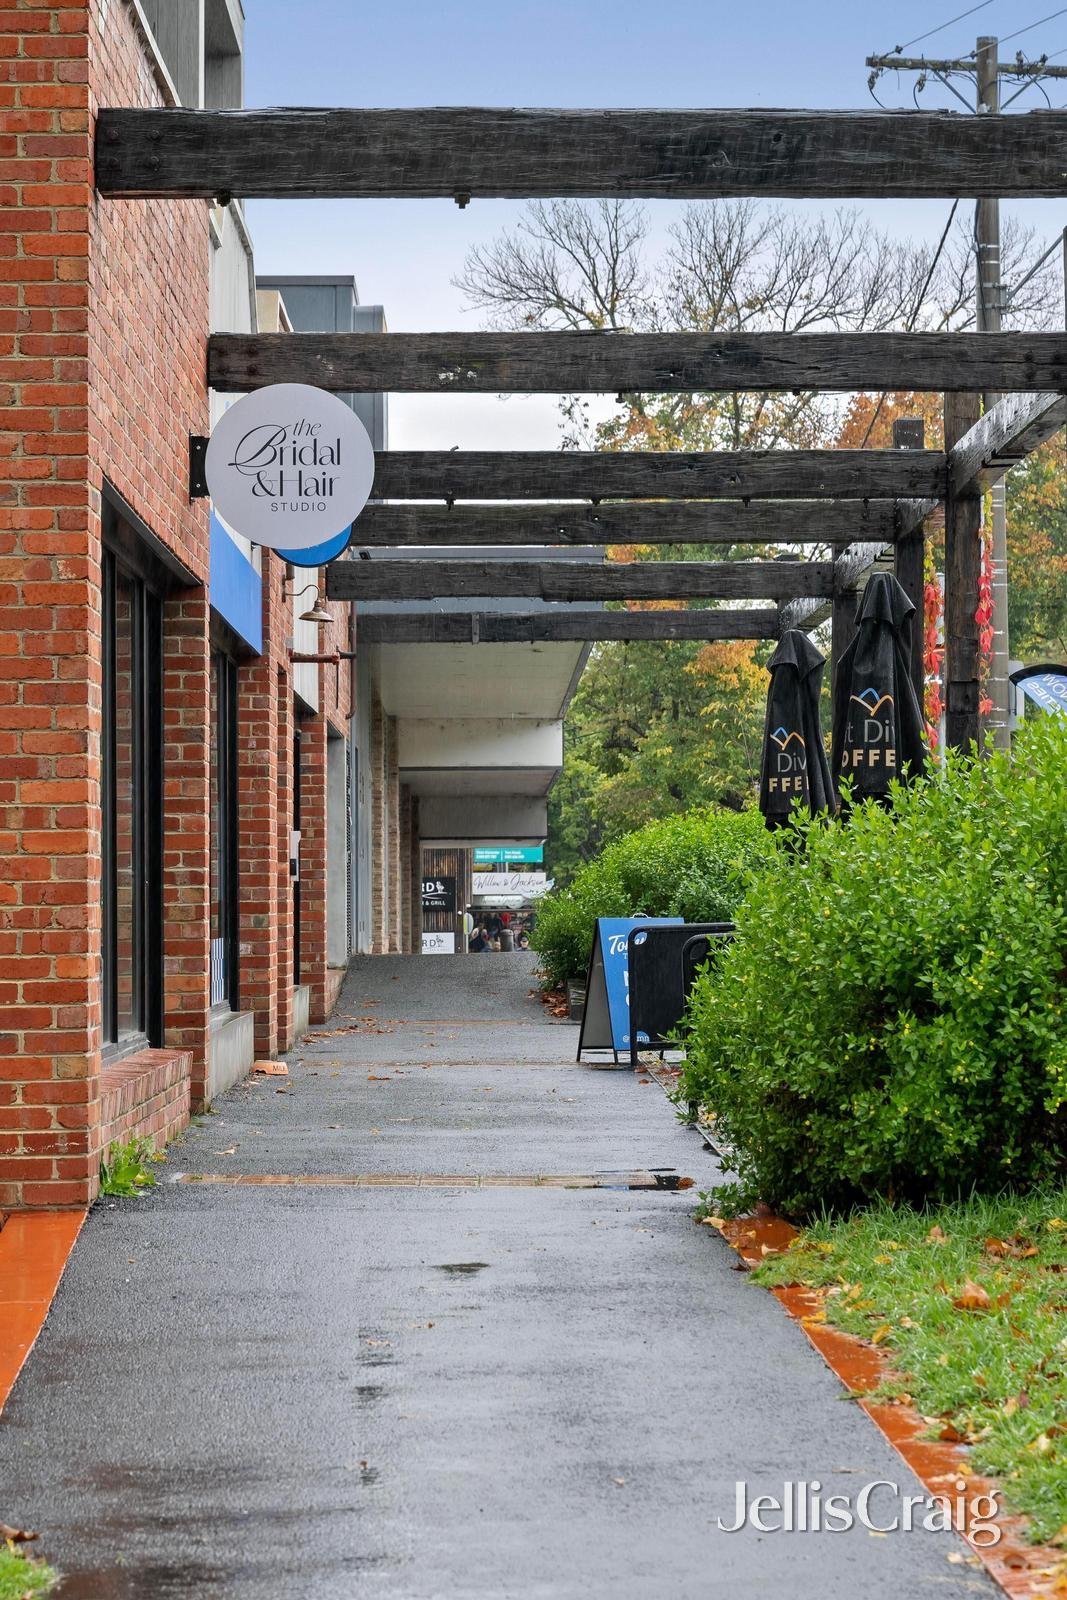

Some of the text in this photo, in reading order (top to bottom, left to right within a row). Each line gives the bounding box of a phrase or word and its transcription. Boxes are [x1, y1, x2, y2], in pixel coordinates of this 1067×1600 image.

[293, 418, 322, 437] the
[228, 424, 340, 476] Bridal
[271, 502, 327, 512] STUDIO
[864, 719, 896, 743] Di
[768, 776, 809, 793] FFE
